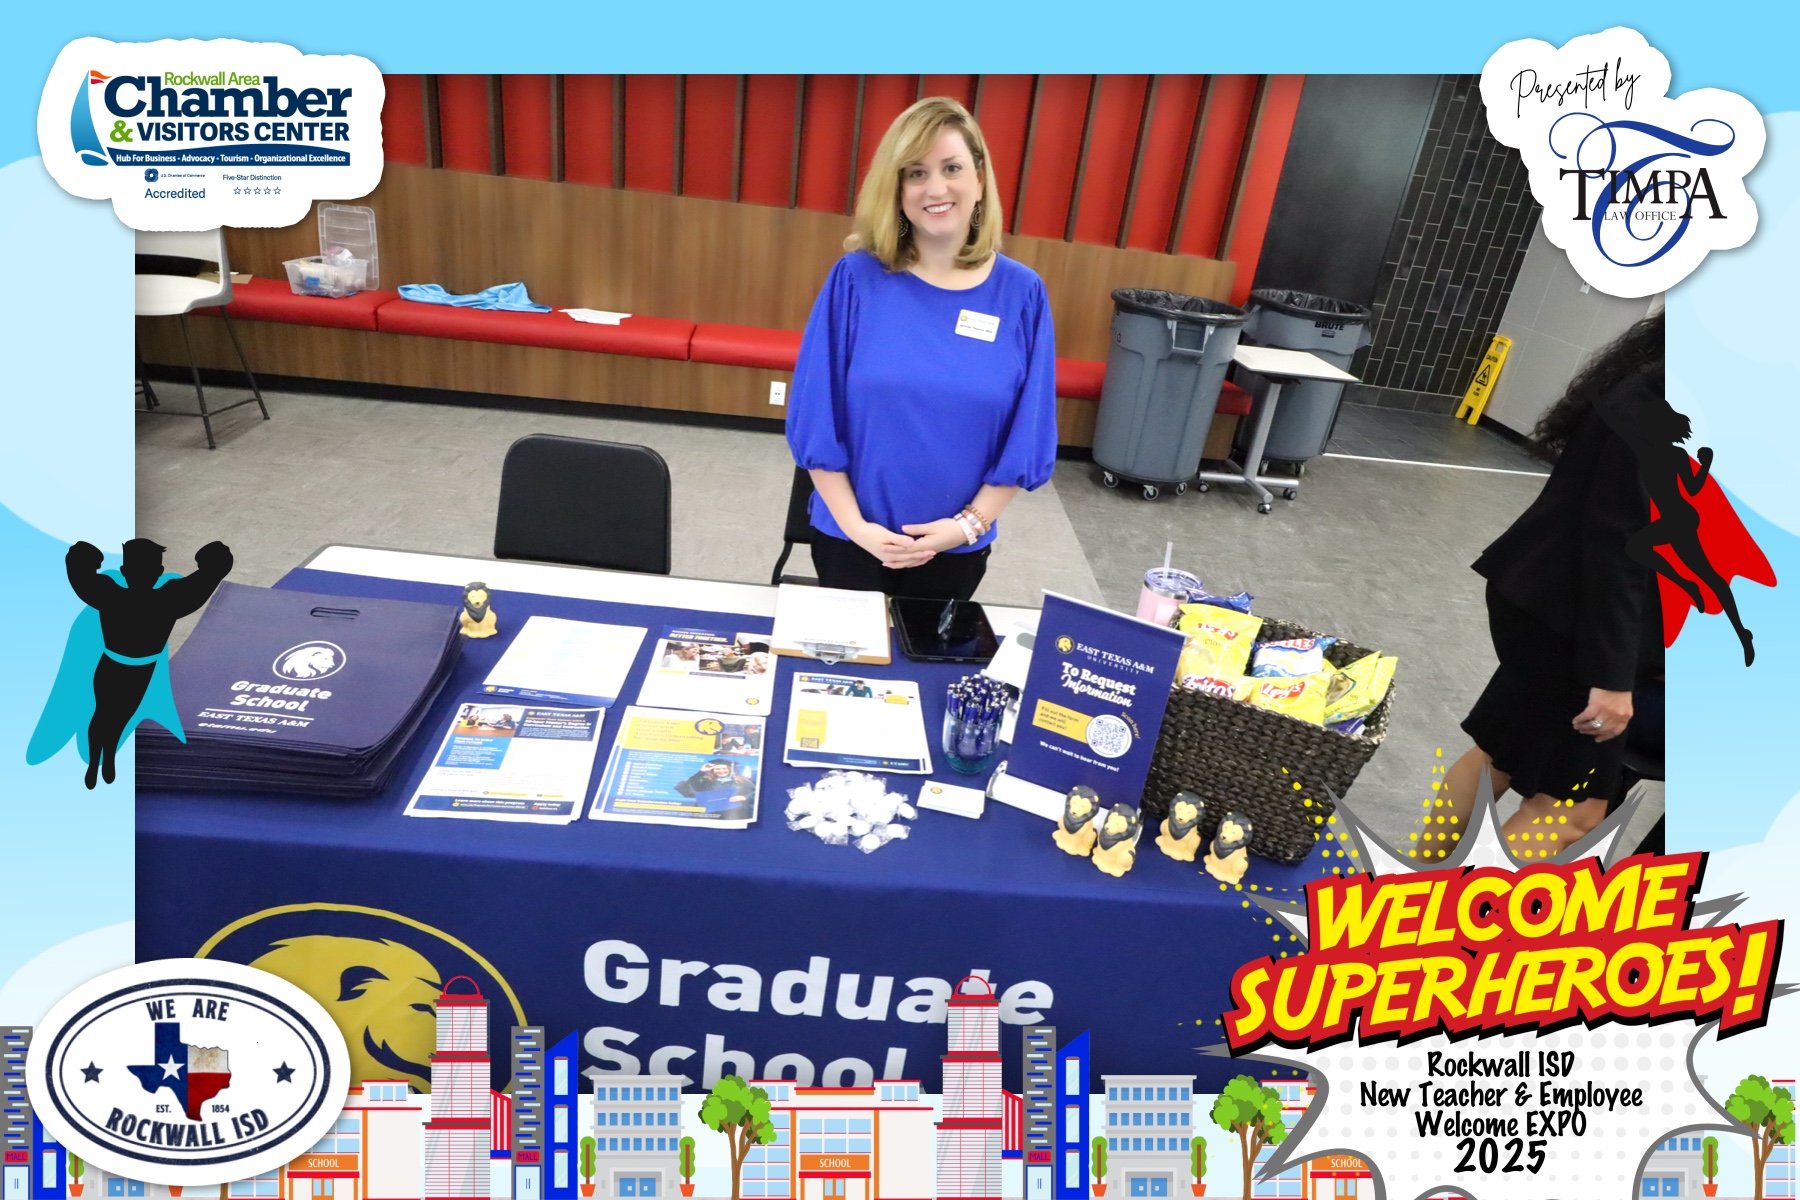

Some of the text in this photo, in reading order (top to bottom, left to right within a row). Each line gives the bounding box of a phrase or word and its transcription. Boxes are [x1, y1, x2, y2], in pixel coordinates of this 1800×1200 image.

[1314, 321, 1345, 331] BRUTE
[1076, 642, 1155, 674] EAST TEXAS A&M
[1087, 655, 1139, 675] UNIVERSITY
[230, 680, 333, 700] Graduate
[1060, 673, 1133, 707] Information
[1062, 661, 1136, 696] To Request
[229, 694, 310, 712] School
[197, 711, 311, 728] EAST TEXAS A&M
[1039, 740, 1049, 748] We
[1048, 744, 1062, 753] can't
[1062, 749, 1074, 757] wait
[1079, 755, 1093, 764] hear
[1092, 760, 1107, 769] from
[1106, 764, 1120, 773] you!
[581, 1026, 908, 1091] School
